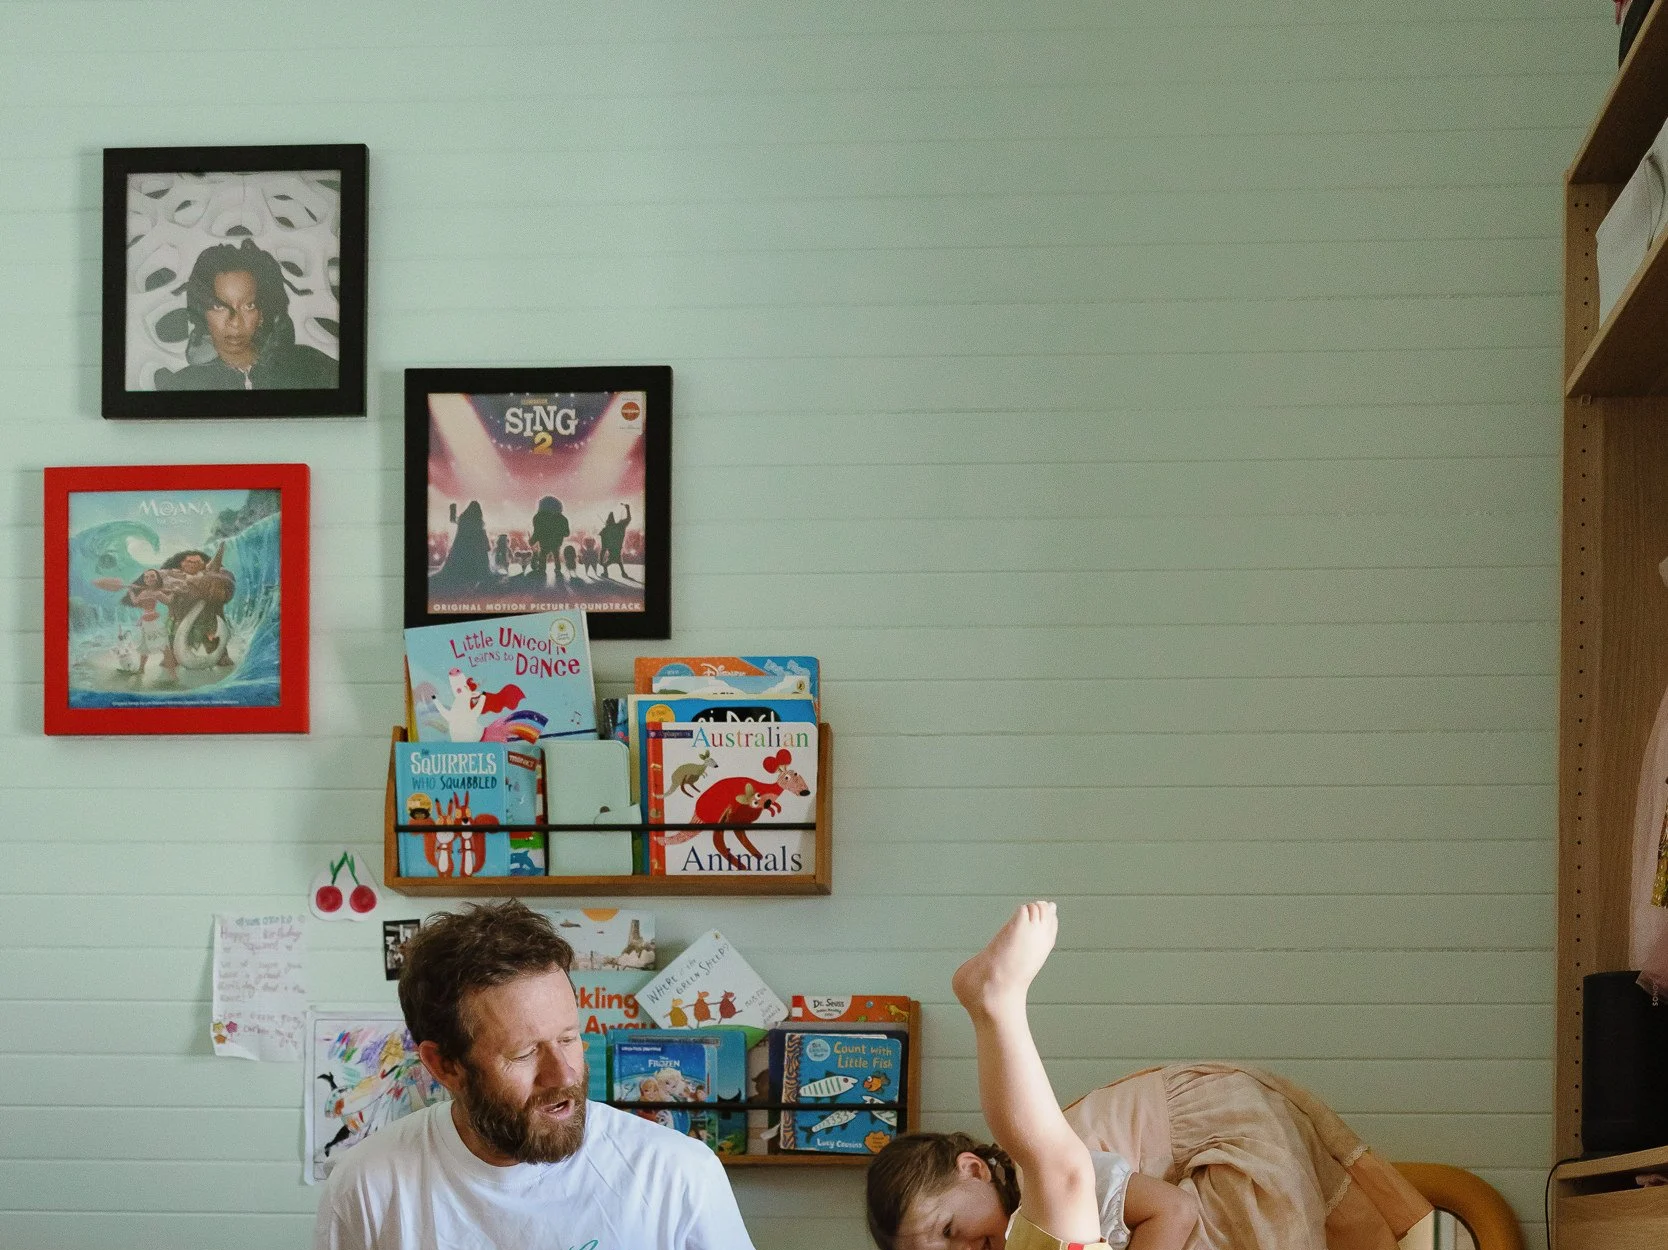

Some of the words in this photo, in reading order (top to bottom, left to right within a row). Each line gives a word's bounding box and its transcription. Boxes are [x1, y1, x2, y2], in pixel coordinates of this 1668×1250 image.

[533, 431, 553, 455] 2
[432, 603, 481, 611] ORIGINAL
[486, 603, 526, 611] MOTION
[449, 630, 494, 659] Little
[503, 652, 514, 662] to
[692, 726, 809, 748] Australian
[410, 751, 497, 775] SQUIRRELS
[412, 777, 436, 790] WHO
[440, 775, 497, 790] SQUABBLED
[681, 845, 803, 872] Animals
[576, 986, 640, 1020] kling
[833, 1041, 866, 1055] Count
[870, 1044, 892, 1056] with
[648, 1059, 681, 1068] FROZEN
[837, 1055, 869, 1069] Little
[872, 1057, 893, 1069] Fish
[816, 1138, 835, 1149] Lucy
